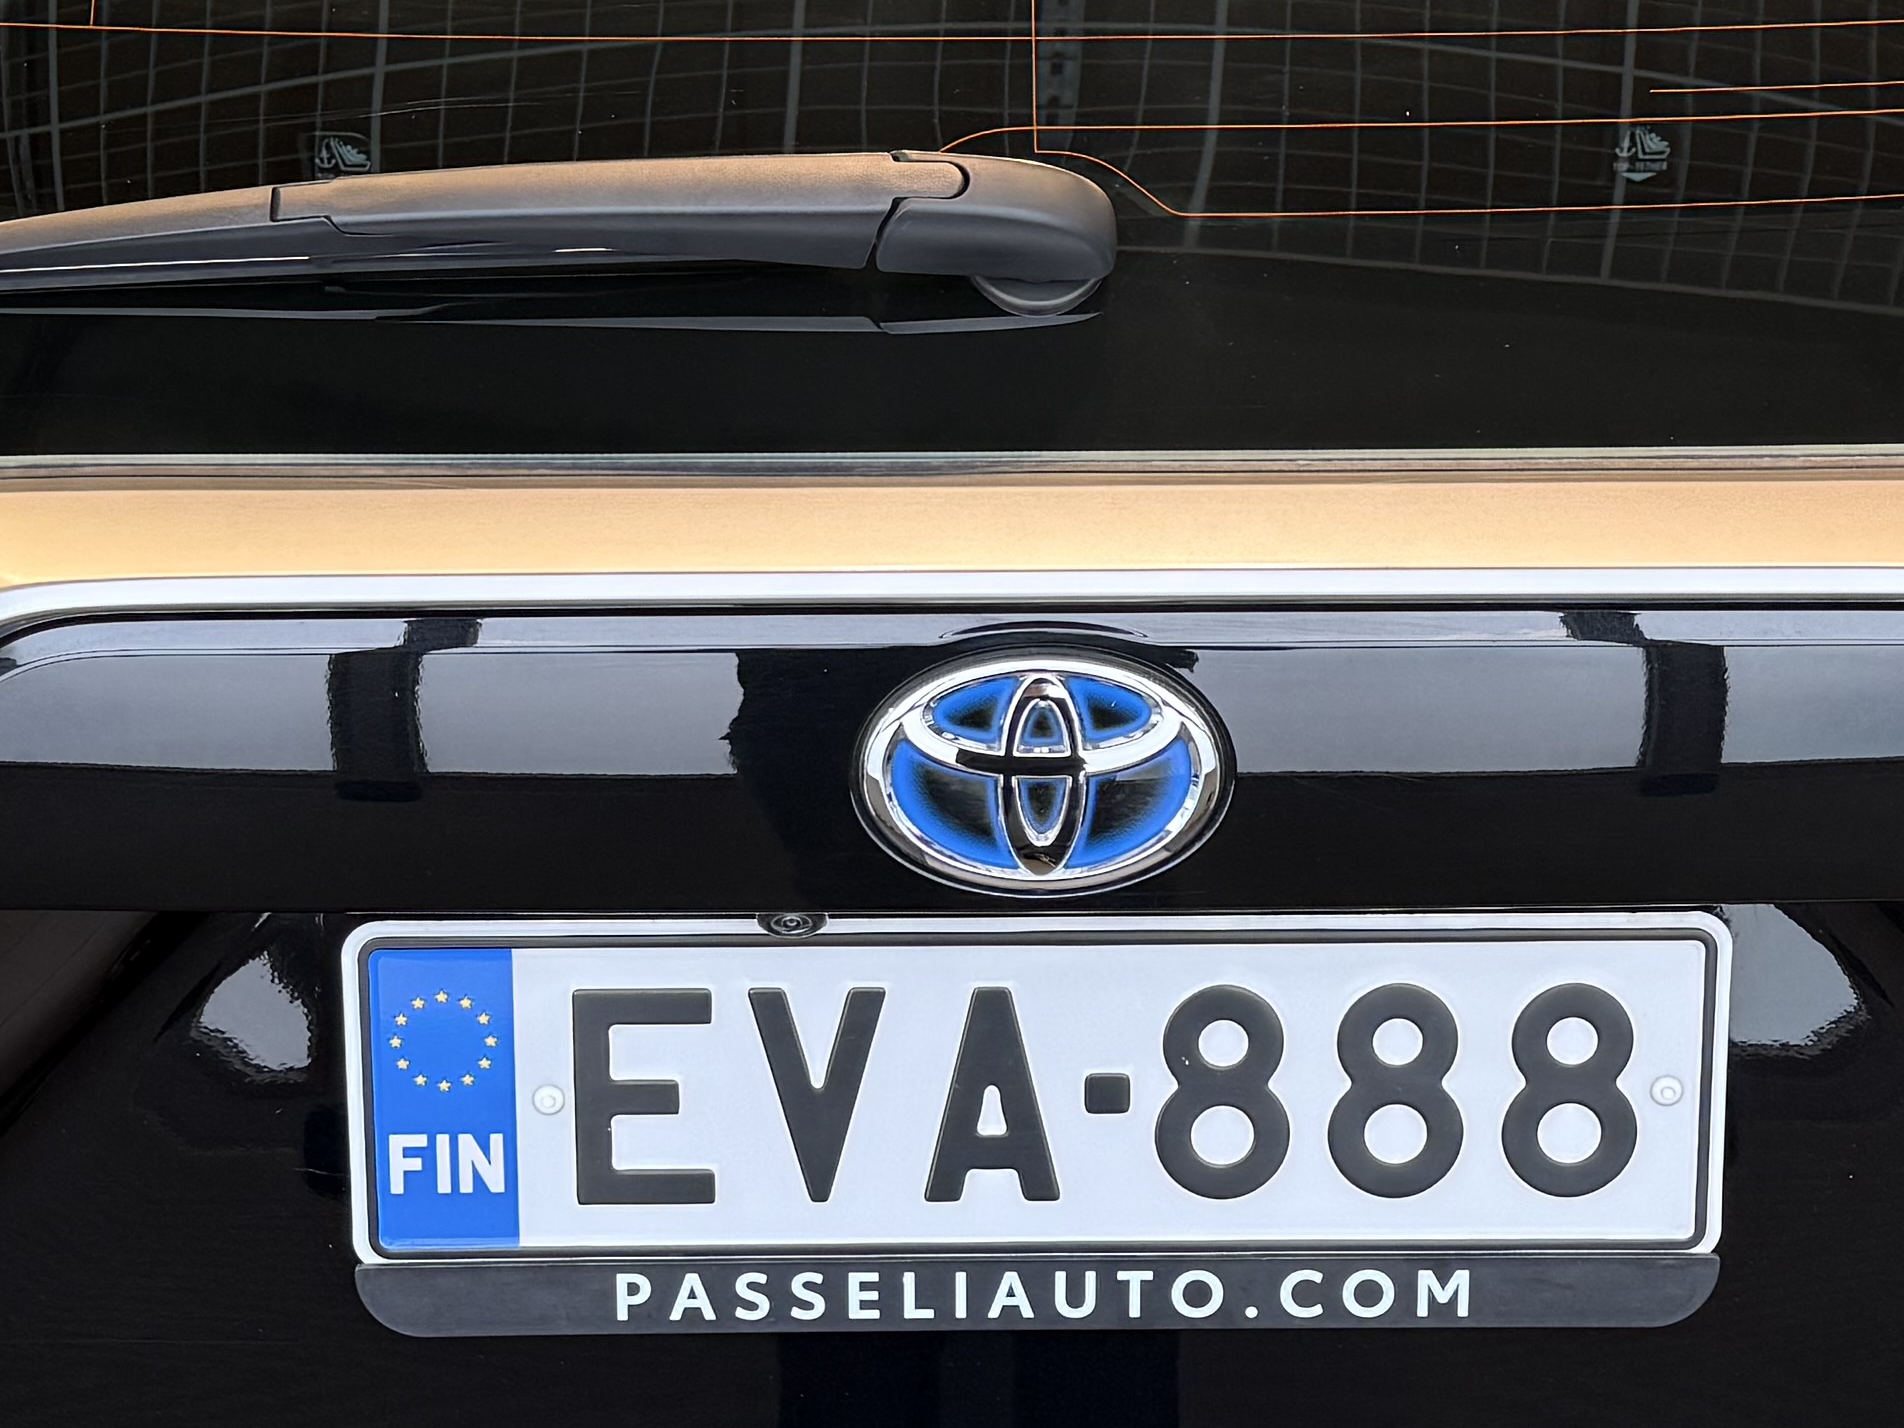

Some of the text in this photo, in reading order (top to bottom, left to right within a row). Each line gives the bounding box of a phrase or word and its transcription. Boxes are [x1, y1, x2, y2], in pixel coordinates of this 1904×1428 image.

[571, 982, 1638, 1206] EVA-888
[388, 1133, 505, 1195] FIN
[615, 1268, 1472, 1322] PASSELIAUTO.COM
